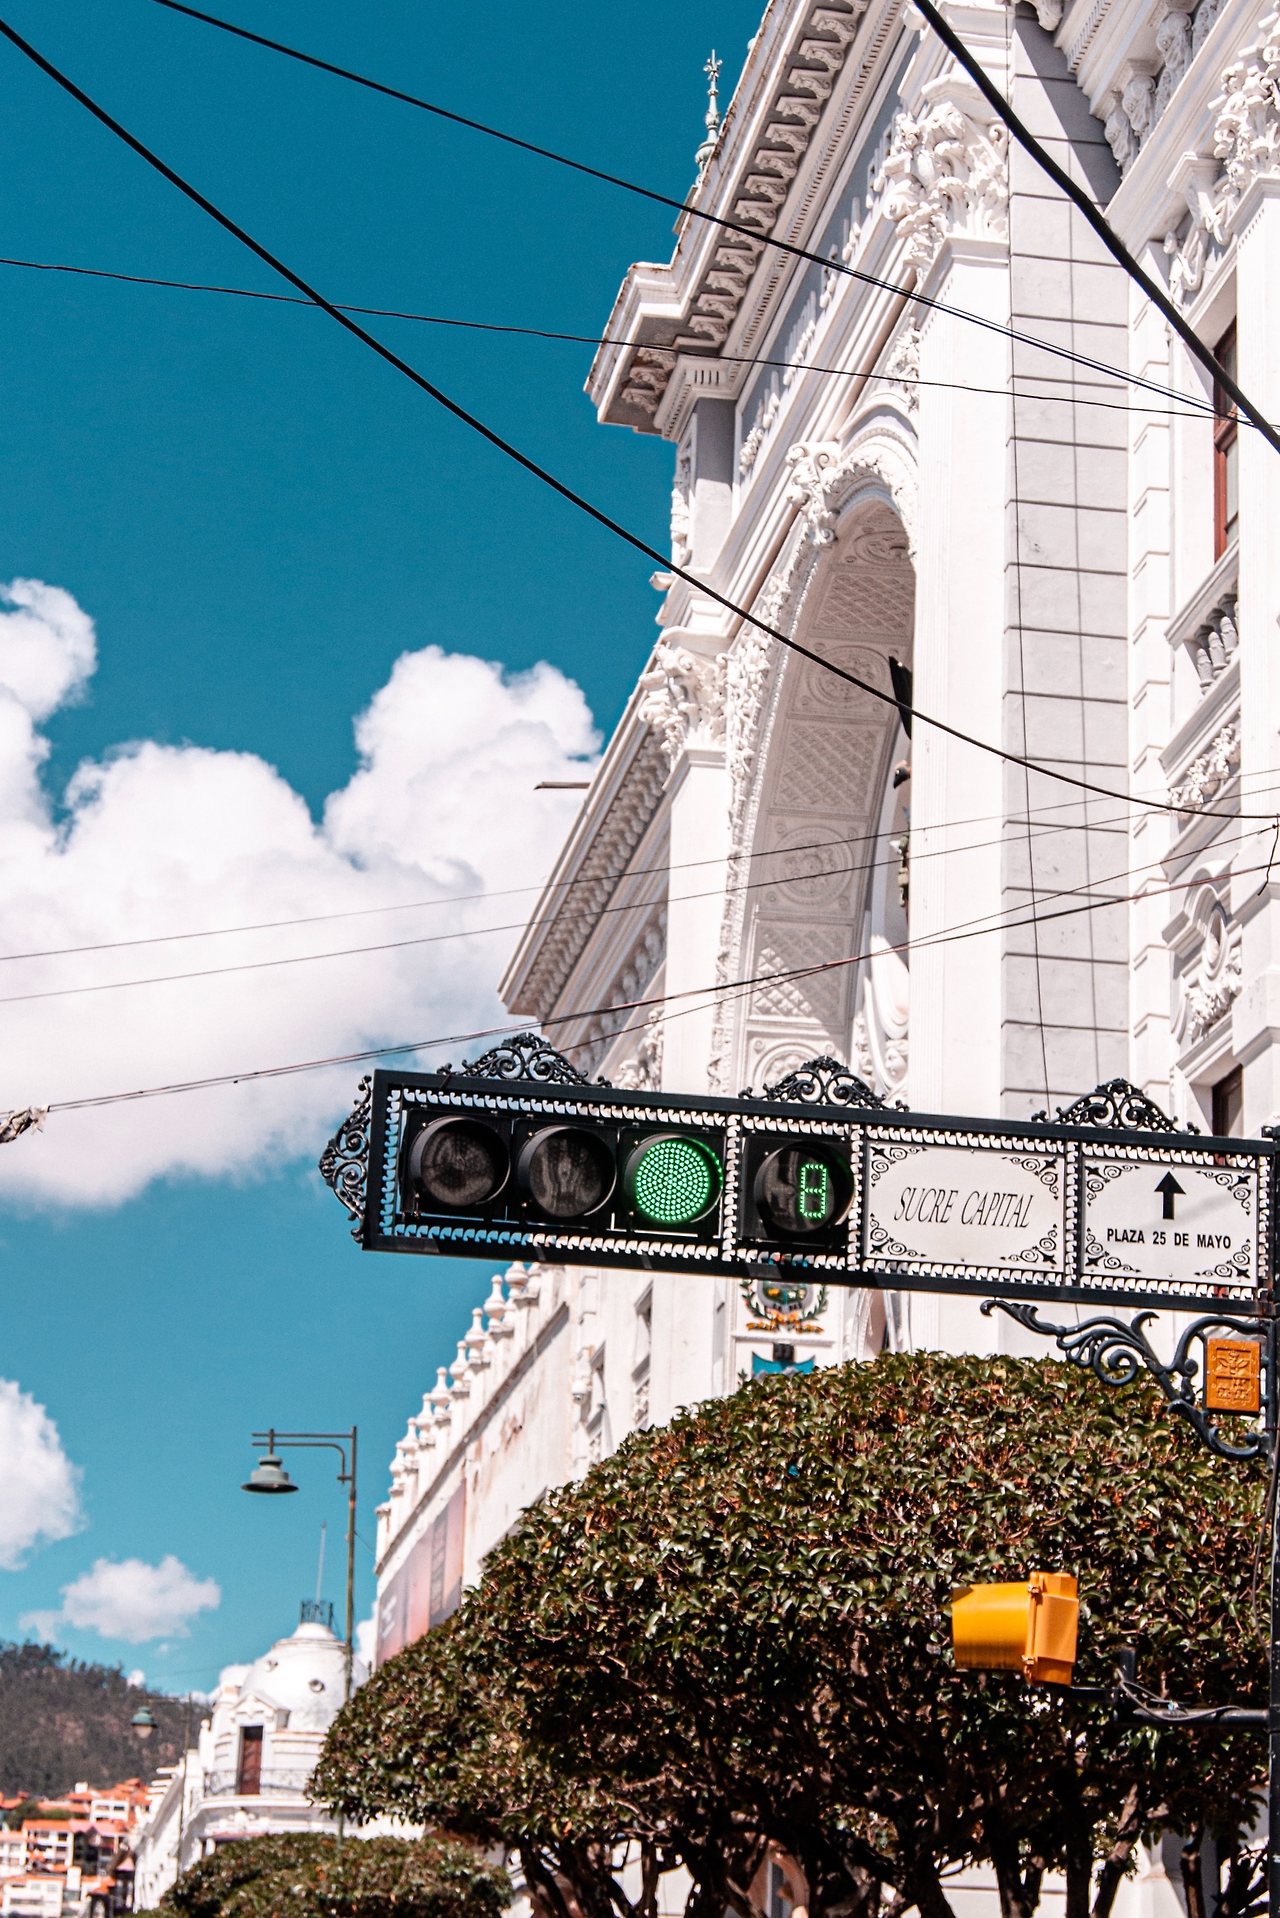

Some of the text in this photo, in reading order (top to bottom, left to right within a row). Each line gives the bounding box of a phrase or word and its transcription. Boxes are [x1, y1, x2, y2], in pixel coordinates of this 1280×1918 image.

[800, 1163, 827, 1218] 8
[893, 1186, 1034, 1228] SUCRE CAPITAL
[1107, 1228, 1231, 1249] PLAZA 25 DE MAYO
